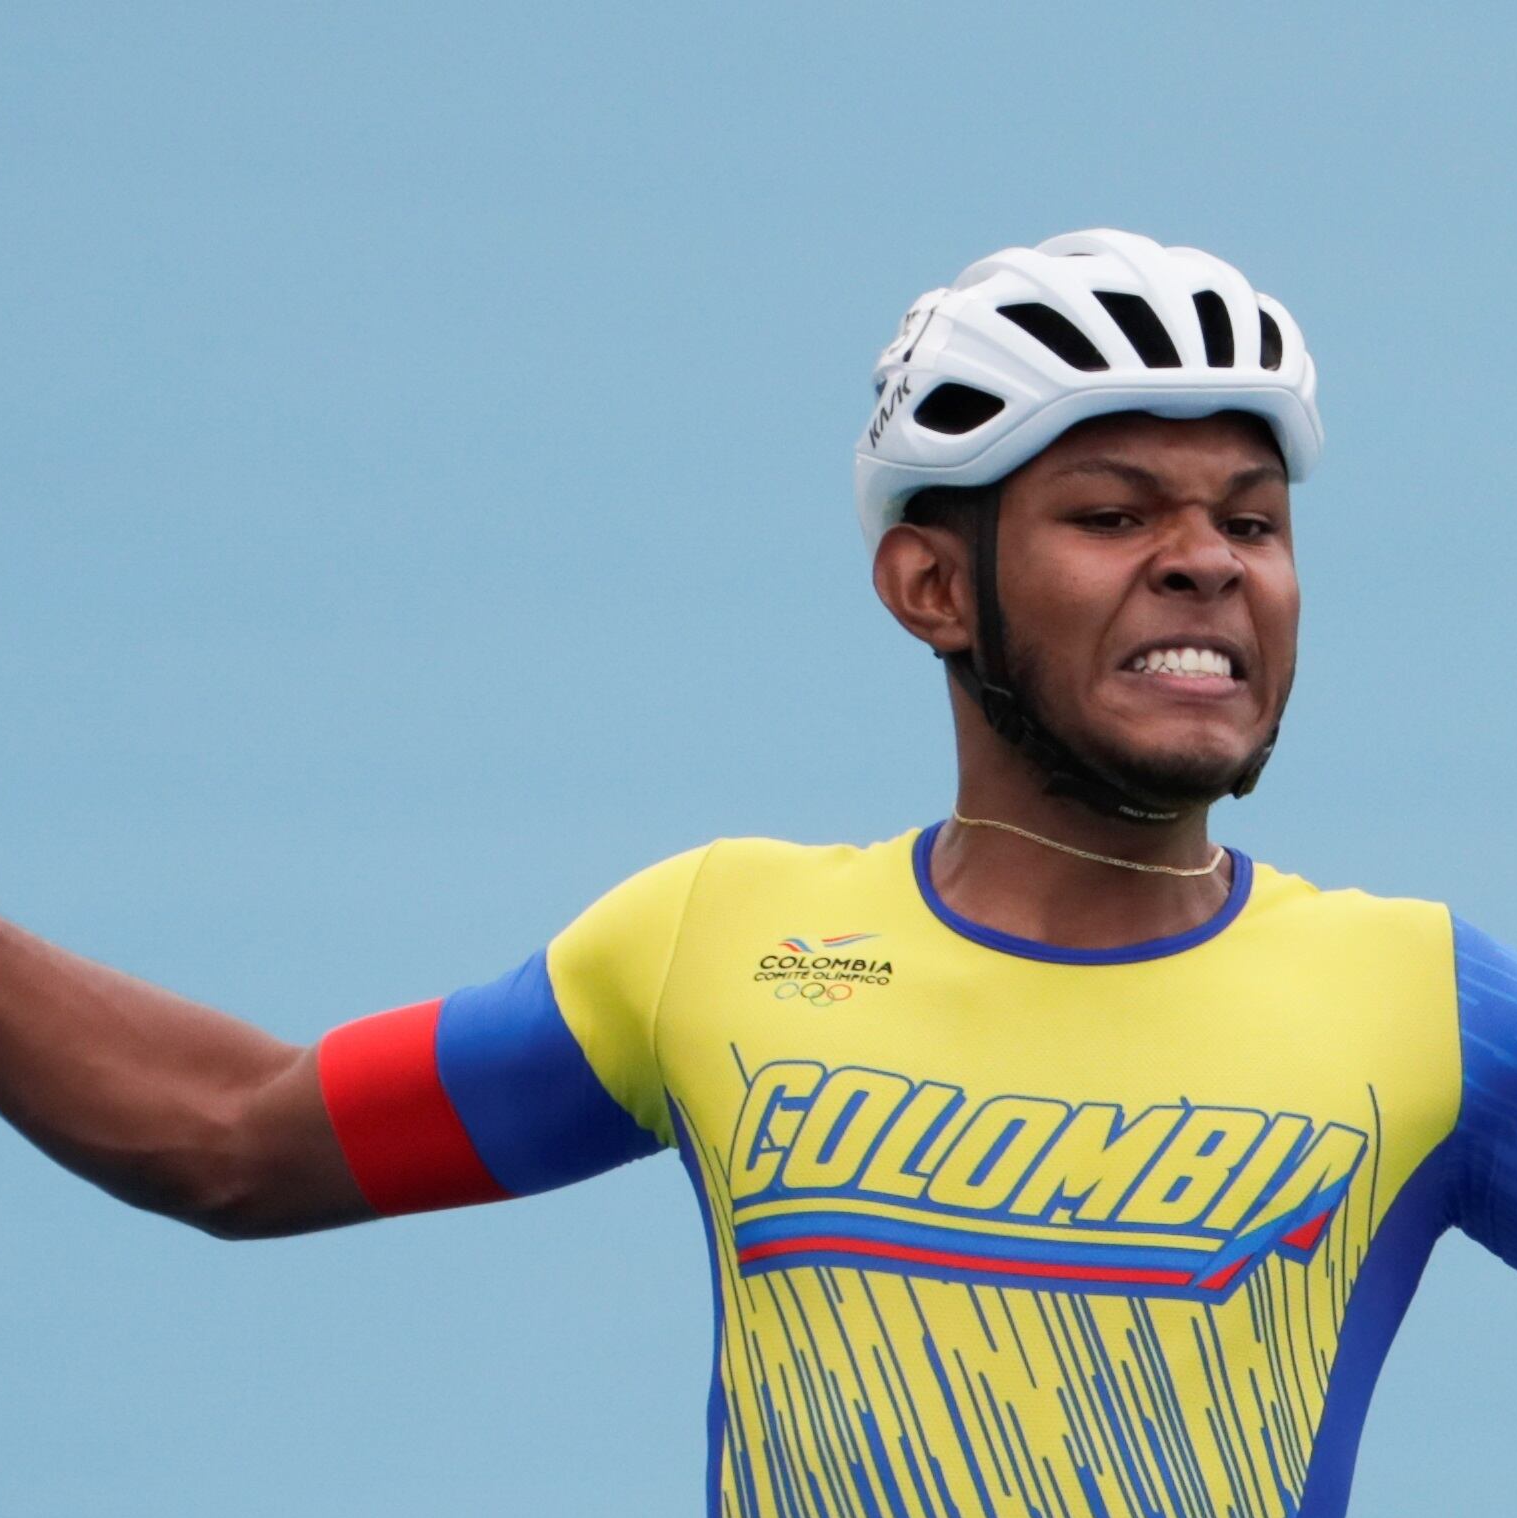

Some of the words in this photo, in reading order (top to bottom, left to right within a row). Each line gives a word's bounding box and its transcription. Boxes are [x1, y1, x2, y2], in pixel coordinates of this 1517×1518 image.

[869, 376, 911, 449] KASK
[760, 955, 893, 975] COLOMBIA
[728, 1059, 1368, 1234] COLOMBIA
